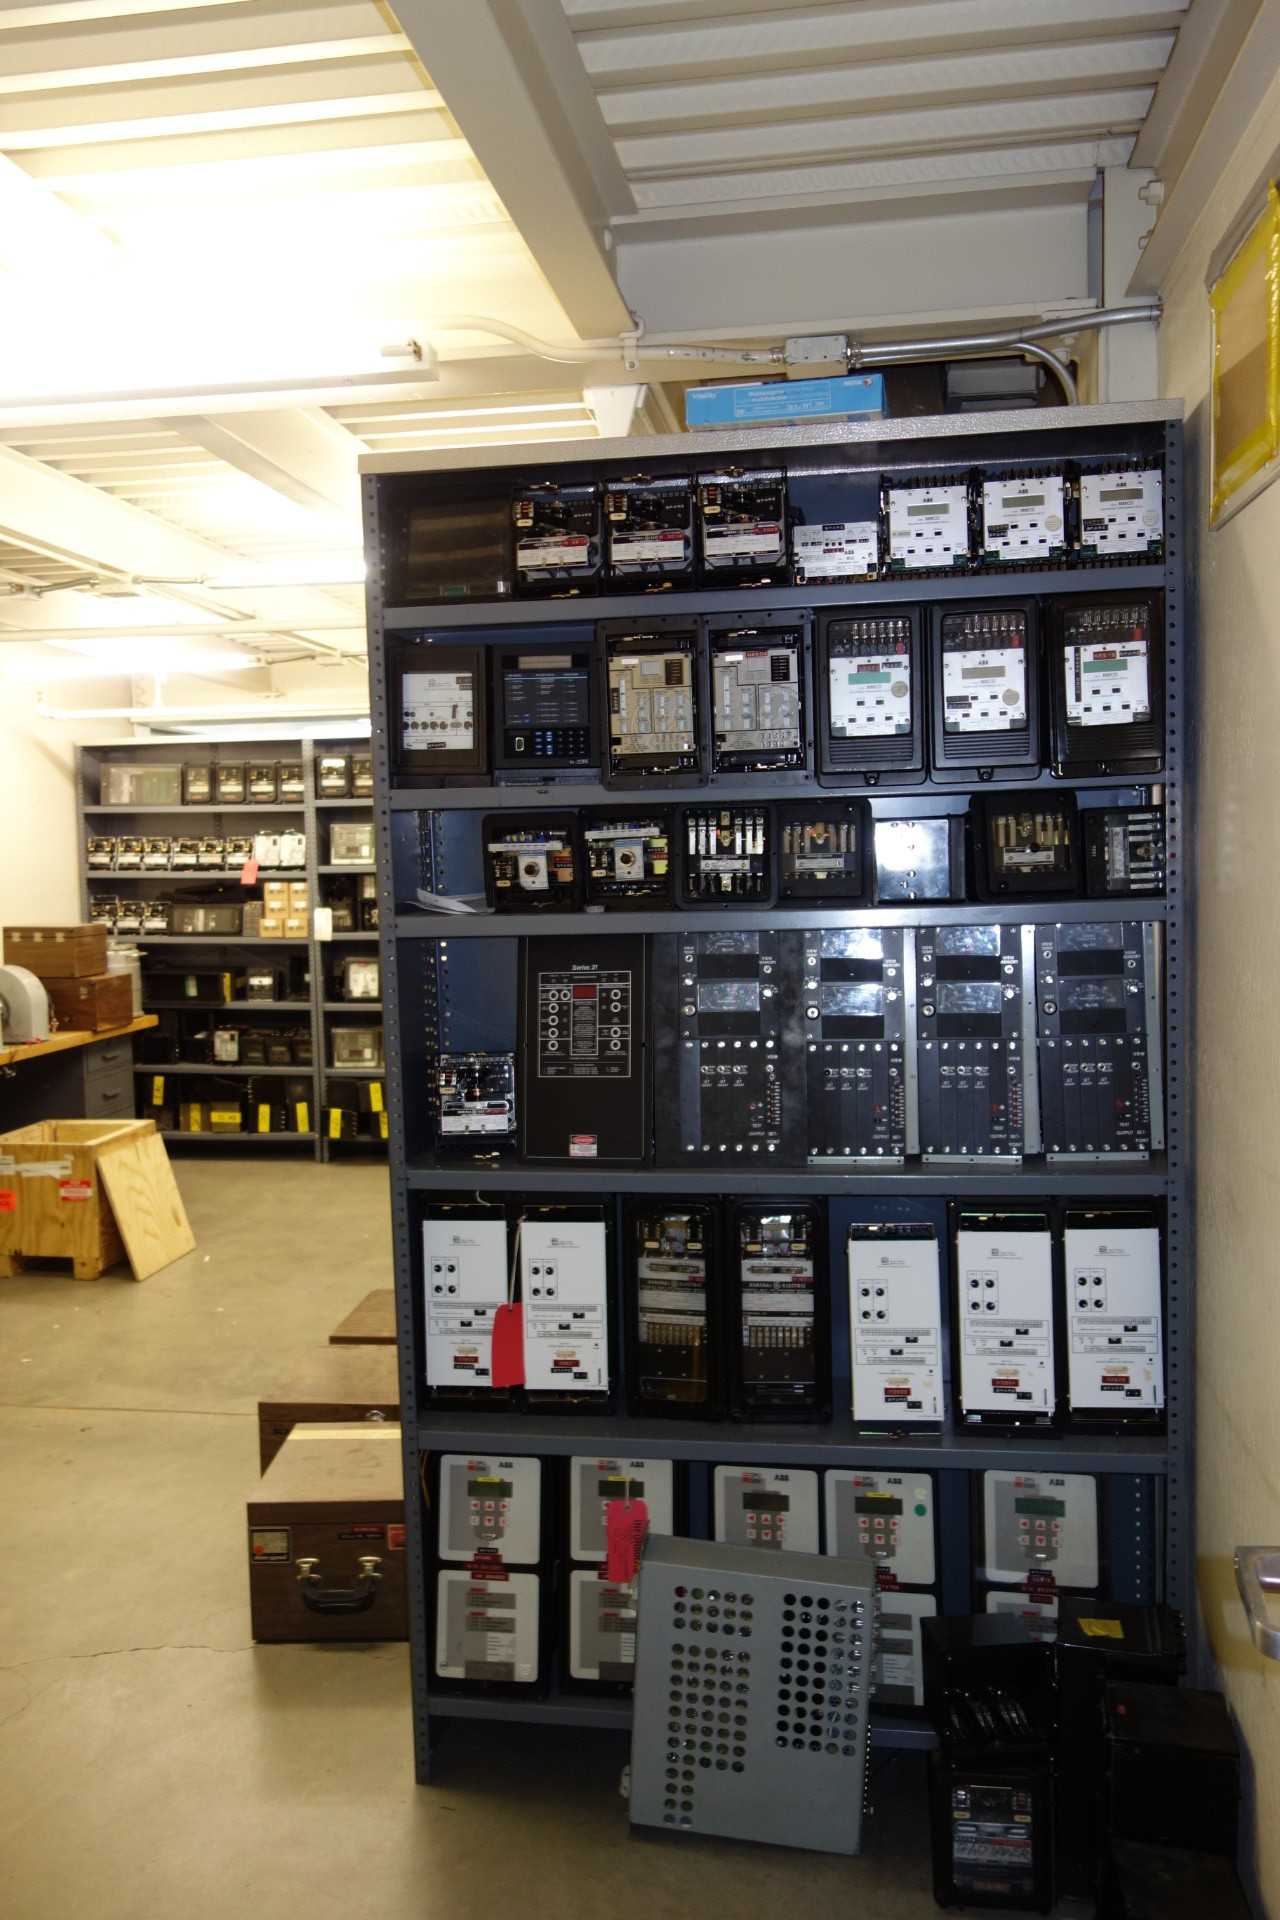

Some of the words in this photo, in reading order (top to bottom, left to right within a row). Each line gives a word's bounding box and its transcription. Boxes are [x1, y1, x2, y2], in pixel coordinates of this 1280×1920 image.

[499, 1461, 513, 1469] ABB
[630, 1461, 645, 1469] ABB
[774, 1474, 790, 1482] ABB
[887, 1477, 903, 1485] ABB
[1049, 1478, 1065, 1487] ABB
